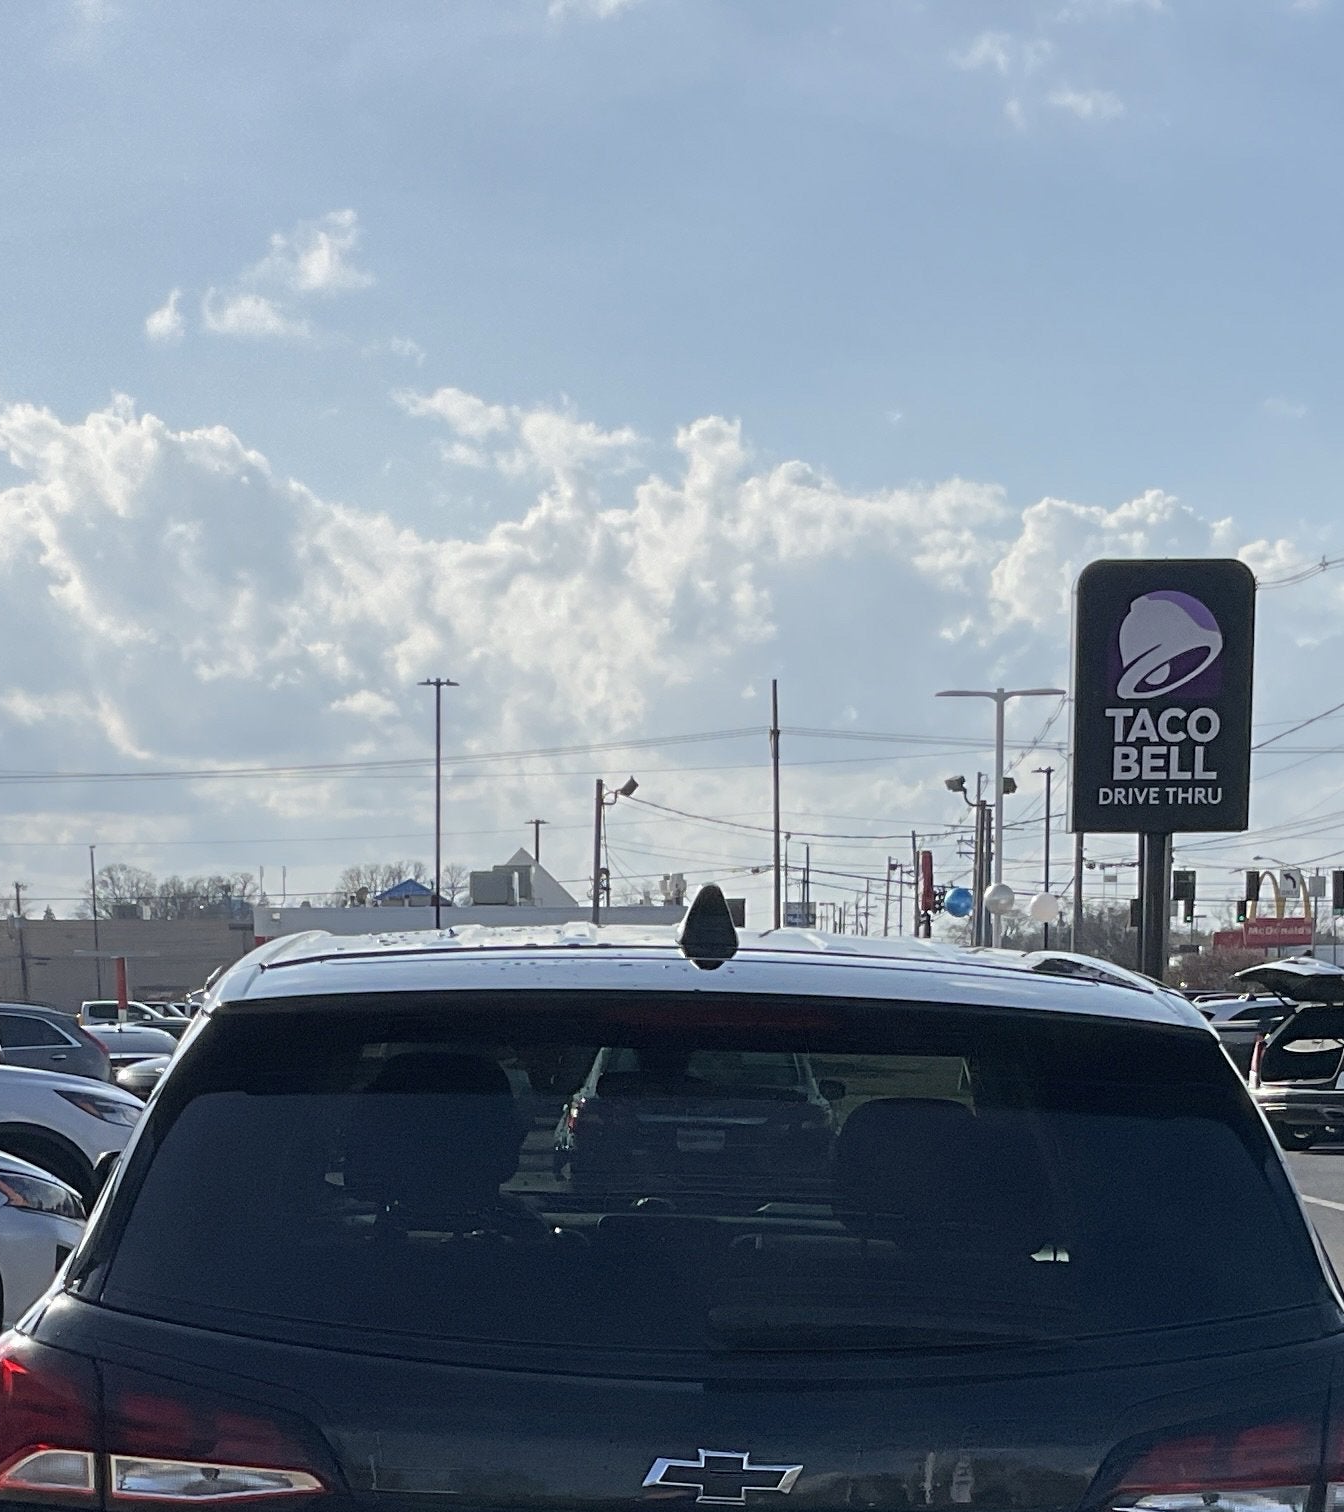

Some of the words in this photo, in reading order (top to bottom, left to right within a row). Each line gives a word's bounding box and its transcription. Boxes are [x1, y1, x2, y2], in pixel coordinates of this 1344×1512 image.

[1105, 707, 1221, 743] TACO
[1112, 745, 1218, 781] BELL
[1098, 787, 1160, 805] DRIVE
[1165, 787, 1223, 805] THRU
